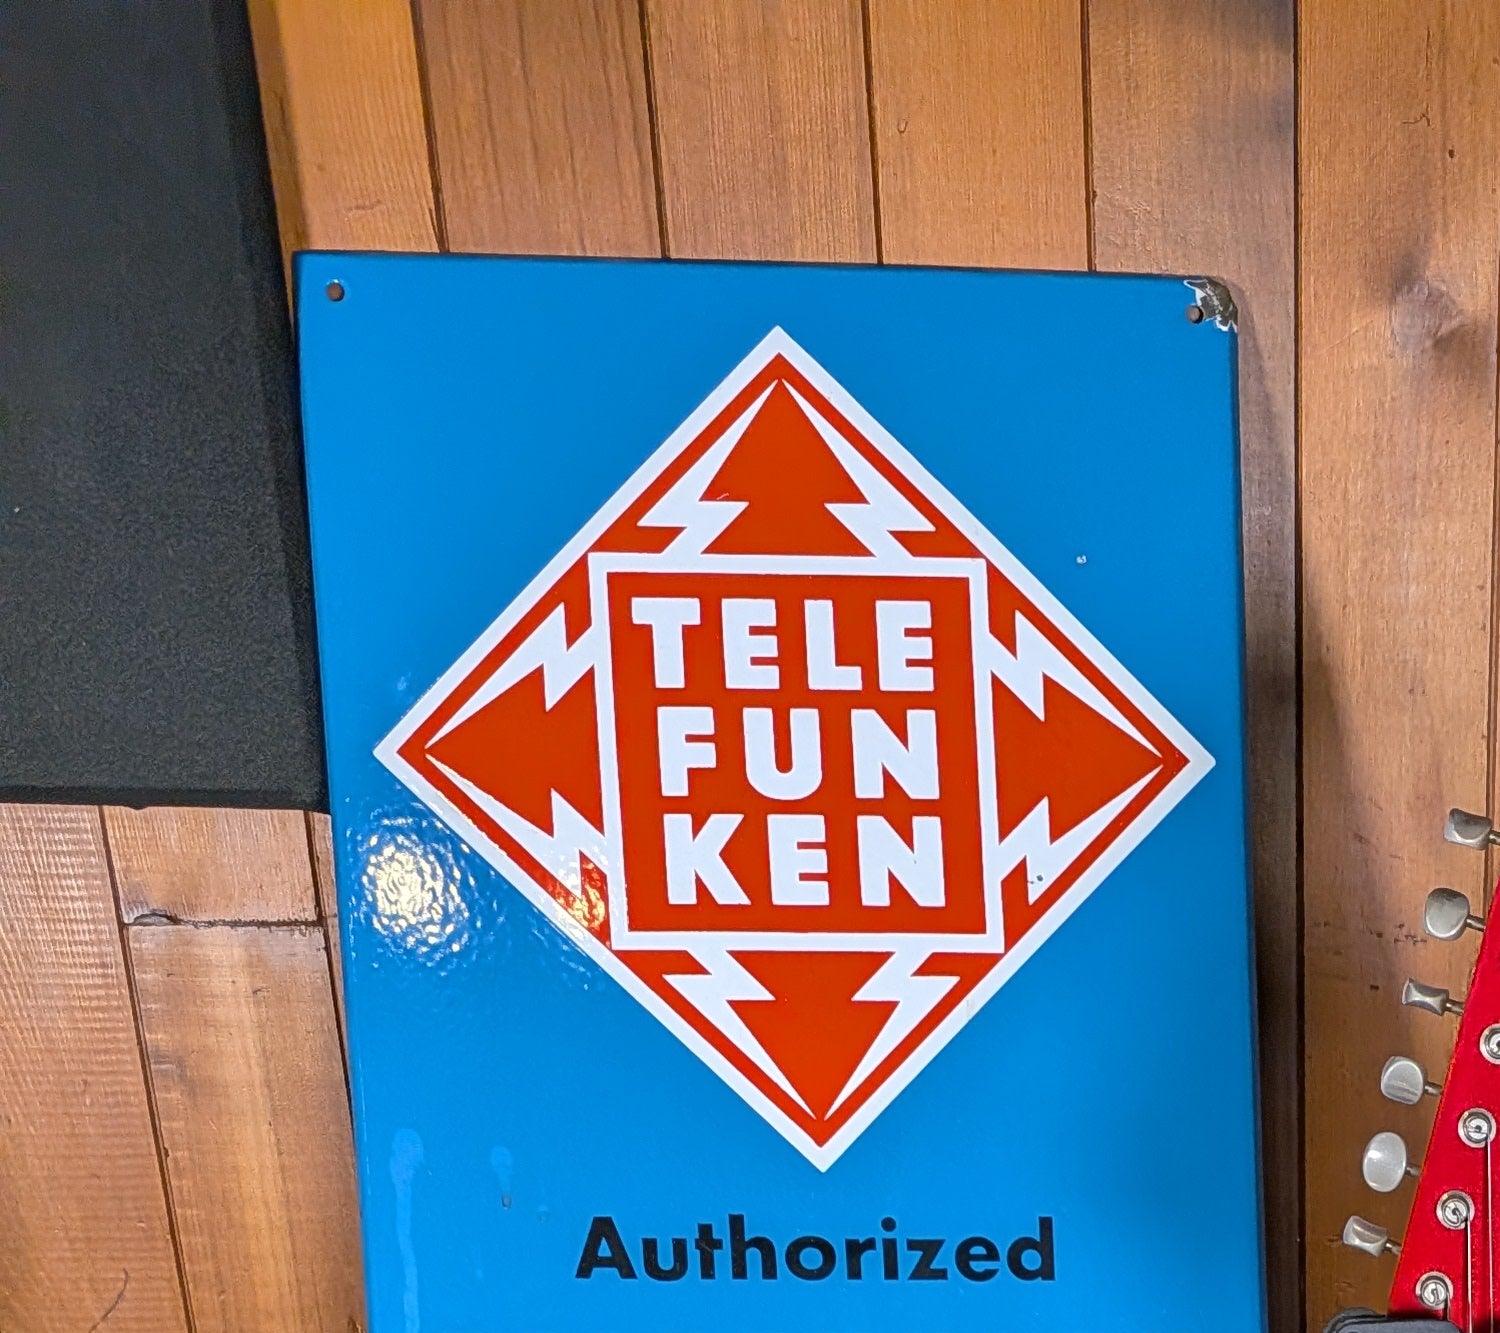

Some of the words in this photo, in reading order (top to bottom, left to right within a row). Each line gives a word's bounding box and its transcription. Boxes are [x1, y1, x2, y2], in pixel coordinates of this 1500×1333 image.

[631, 597, 934, 692] TELE
[657, 706, 940, 800] FUN
[666, 813, 946, 909] KEN
[575, 1214, 1057, 1282] Authorized
